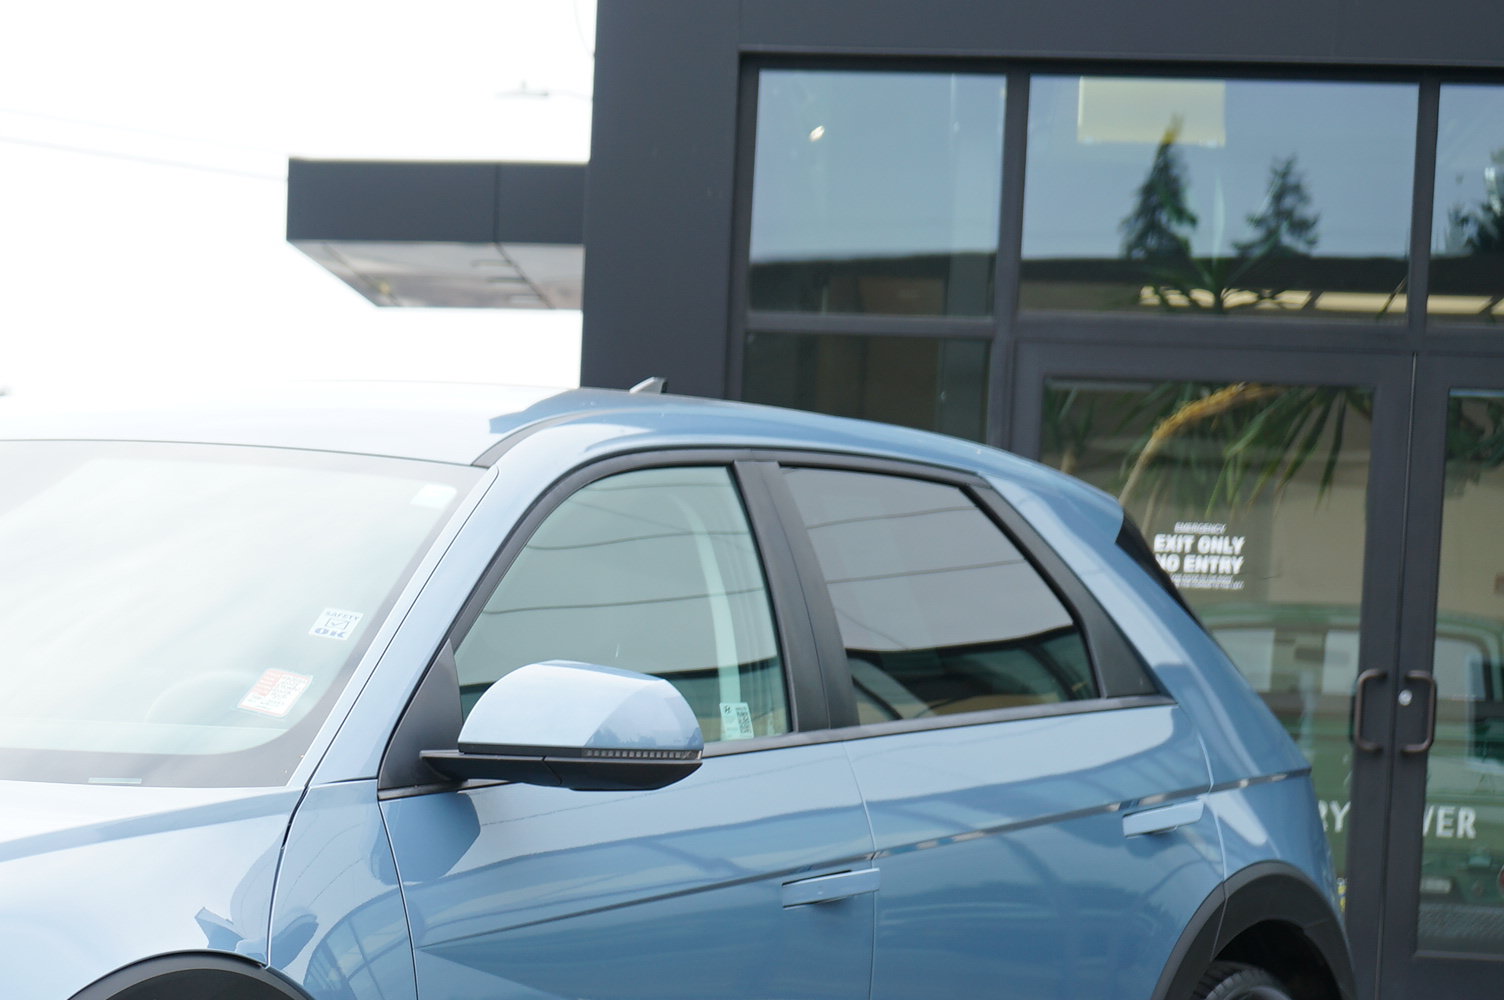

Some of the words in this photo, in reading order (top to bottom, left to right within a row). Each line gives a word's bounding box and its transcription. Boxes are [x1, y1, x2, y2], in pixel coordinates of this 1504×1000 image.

[1174, 521, 1226, 534] EMERGENCY
[1154, 533, 1195, 553] EXIT
[1198, 535, 1245, 555] ONLY
[1183, 554, 1244, 574] ENTRY
[326, 610, 360, 622] SAFETY
[314, 628, 346, 638] OK
